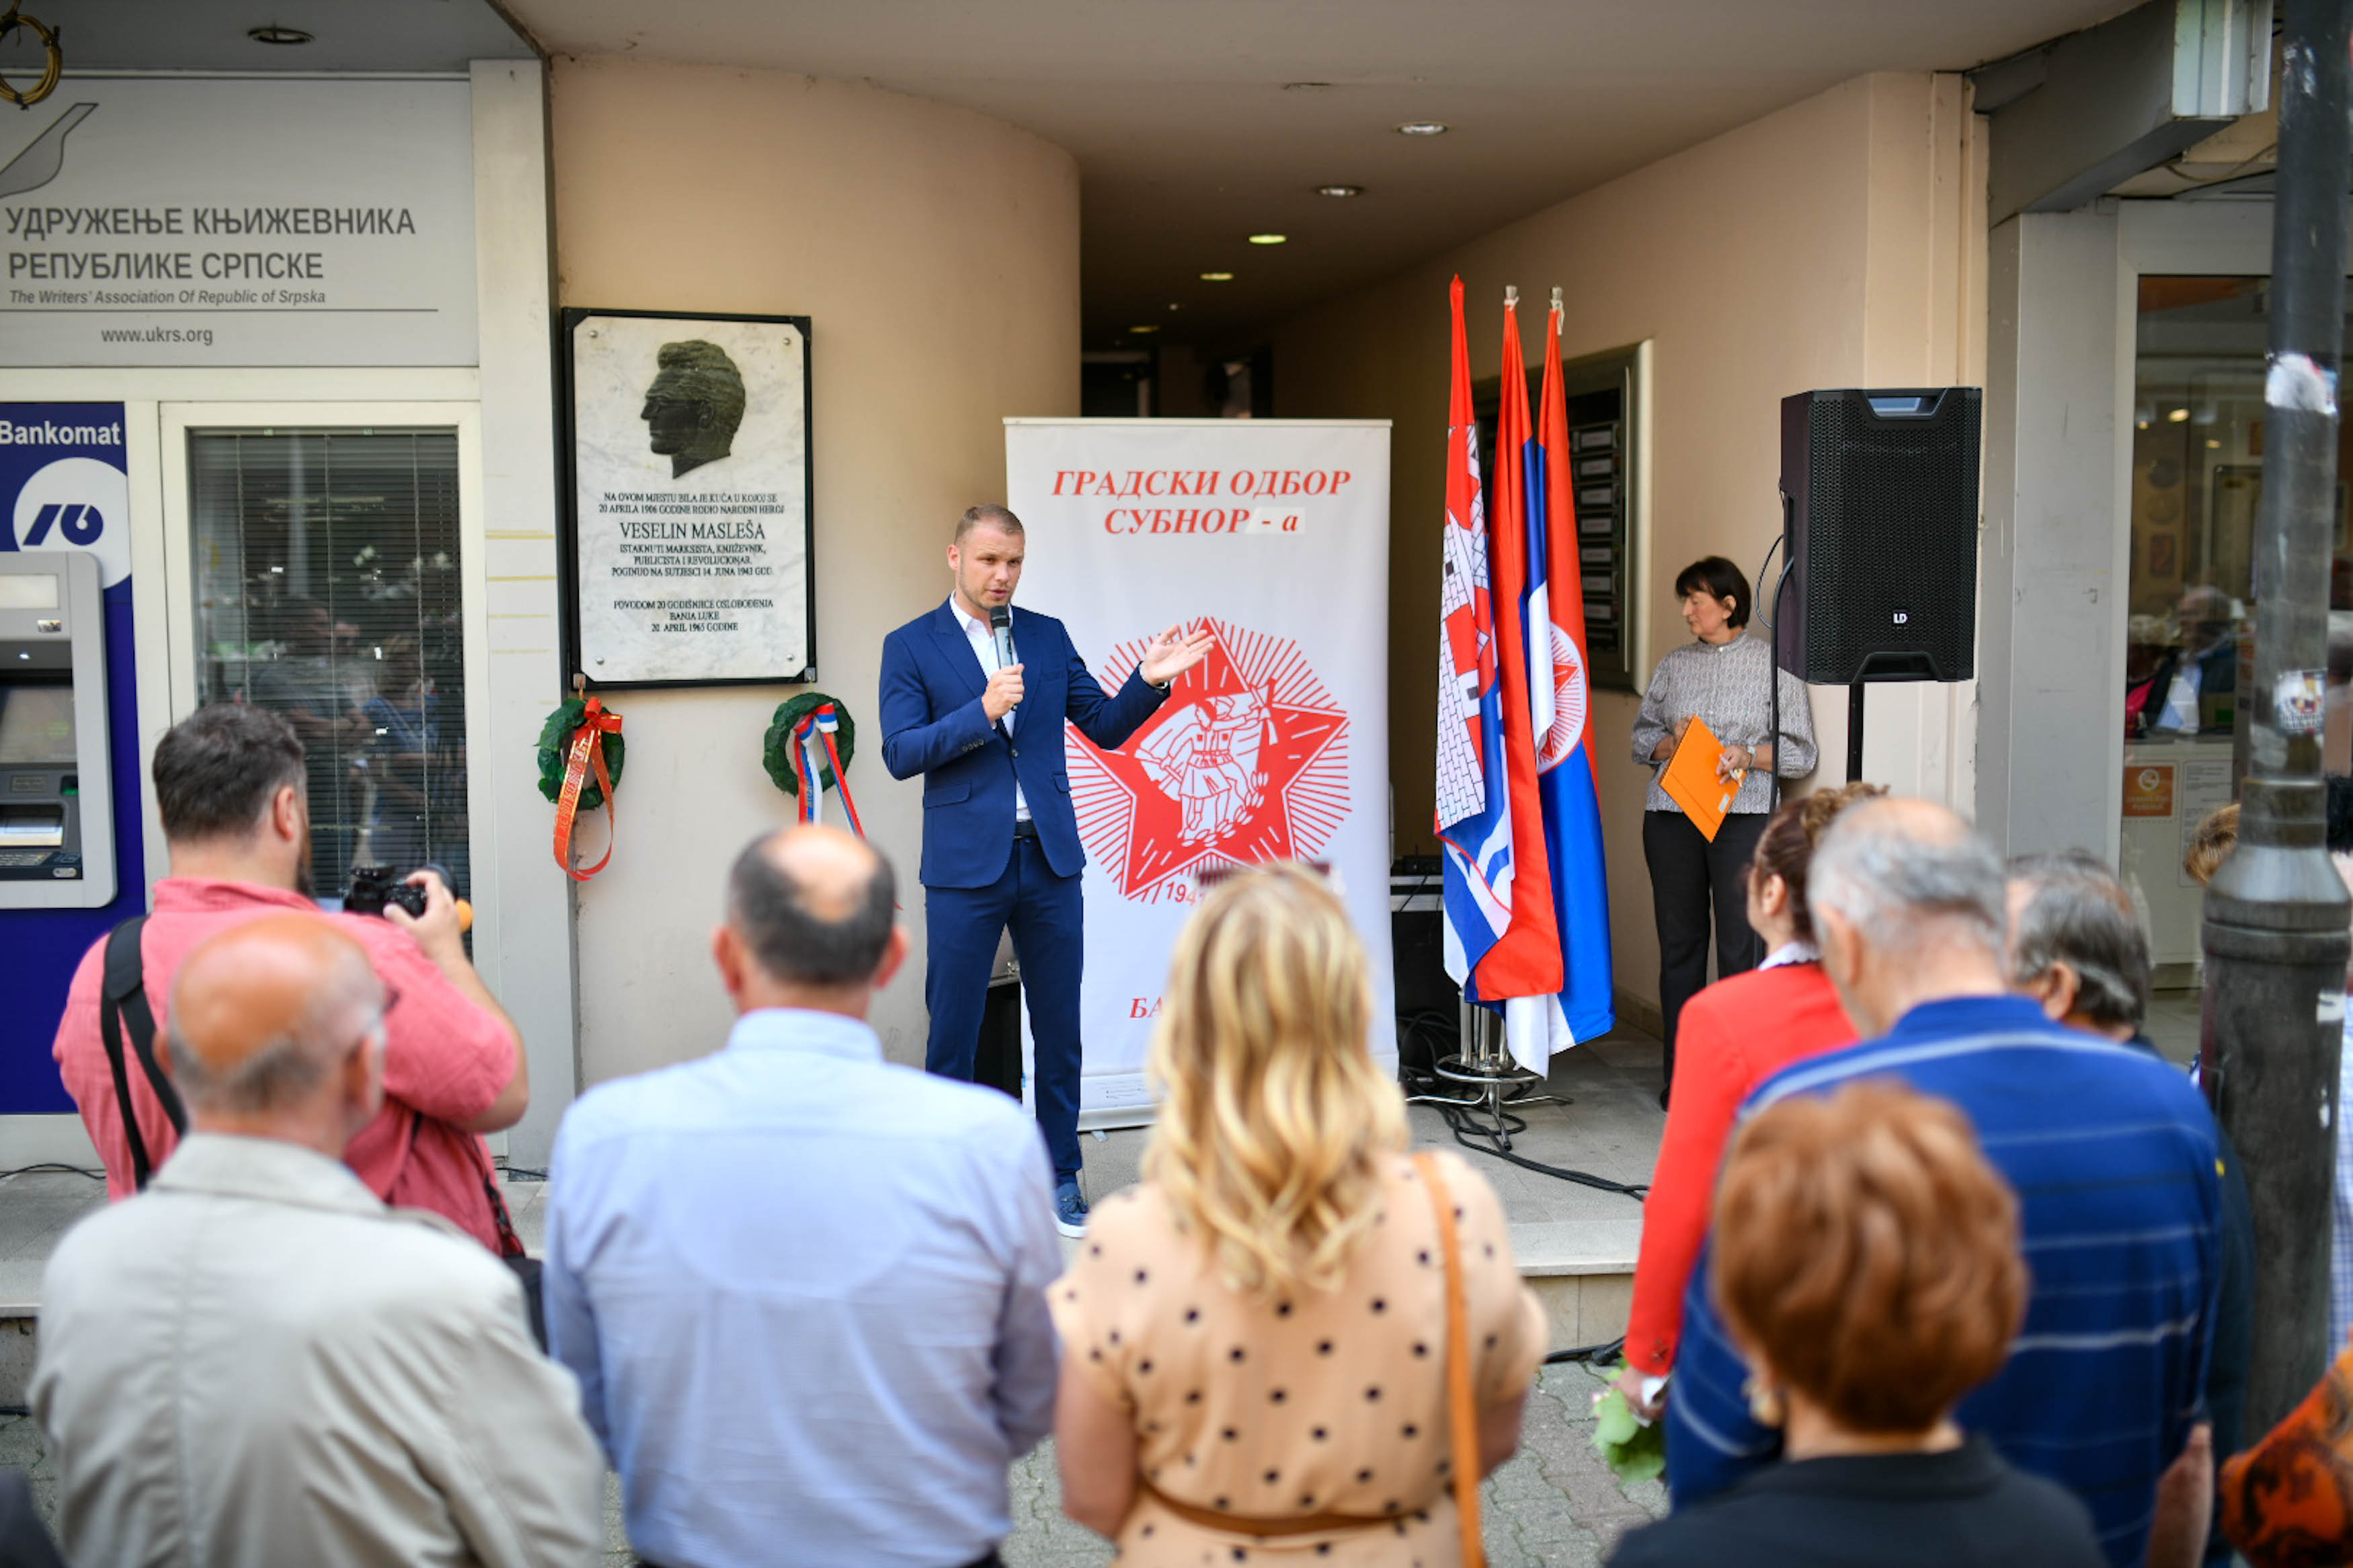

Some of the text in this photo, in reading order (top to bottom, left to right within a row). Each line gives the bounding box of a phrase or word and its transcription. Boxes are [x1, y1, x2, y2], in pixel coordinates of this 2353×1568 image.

[6, 208, 416, 240] УДРУЖЕЊЕ КЊИЖЕВНИКА
[9, 253, 324, 279] РЕПУБЛИКЕ СРПСКЕ
[10, 290, 325, 304] The Writers' Association Of Republic of Srpska
[102, 327, 213, 345] www.ukrs.org
[0, 420, 121, 445] Bankomat
[1051, 470, 1351, 500] ГРАДСКИ ОДБОР
[604, 492, 616, 501] NA
[734, 493, 740, 503] U
[767, 494, 777, 503] SE
[620, 520, 766, 538] VESELIN MASLEŠA
[1105, 509, 1249, 535] СУБНОР
[620, 544, 664, 553] ISTAKNUTI
[634, 556, 680, 565] PUBLICISTA
[682, 556, 686, 565] I
[612, 567, 649, 577] POGINUO
[651, 567, 663, 576] NA
[670, 612, 719, 620] BANJA LUKE
[1893, 613, 1908, 624] LD
[664, 624, 687, 632] APRIL
